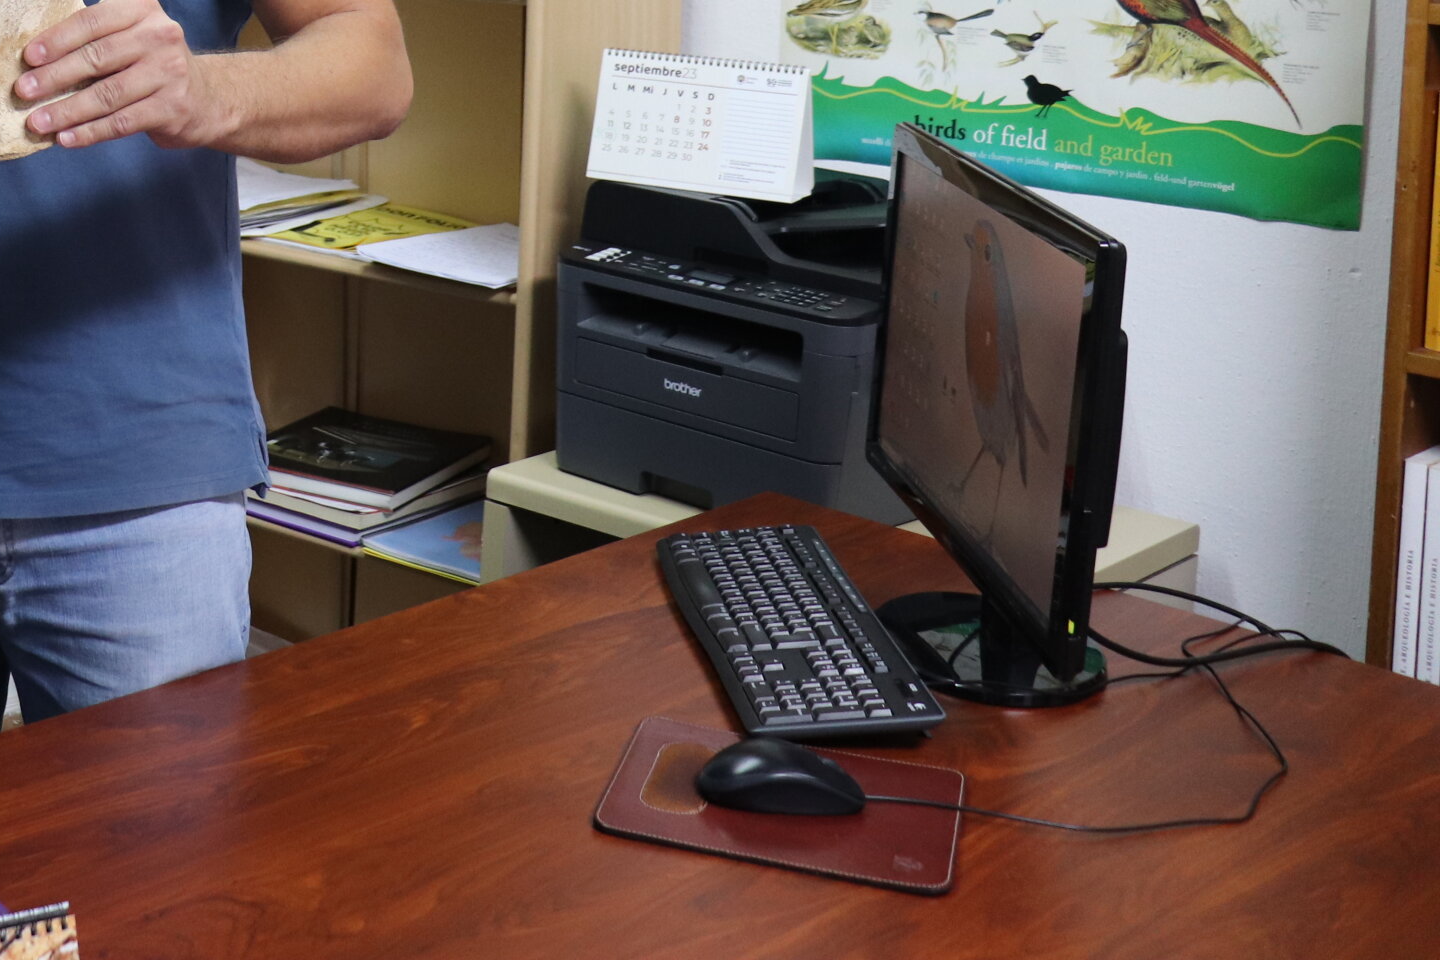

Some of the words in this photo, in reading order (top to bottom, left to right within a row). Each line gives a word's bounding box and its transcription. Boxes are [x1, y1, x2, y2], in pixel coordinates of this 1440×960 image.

[614, 63, 682, 78] septiembre
[612, 82, 618, 90] L
[627, 84, 635, 92] M
[642, 85, 654, 94] Mi
[692, 91, 698, 99] S
[708, 93, 715, 101] D
[702, 118, 712, 127] 10
[701, 131, 710, 139] 17
[914, 115, 967, 140] birds
[973, 123, 999, 144] of
[1001, 125, 1047, 151] field
[1054, 134, 1093, 157] and
[1099, 141, 1174, 167] garden
[697, 143, 709, 151] 24
[1083, 164, 1093, 172] de
[1093, 167, 1118, 177] campo
[663, 378, 702, 398] brother
[1406, 549, 1414, 591] HISTORIA
